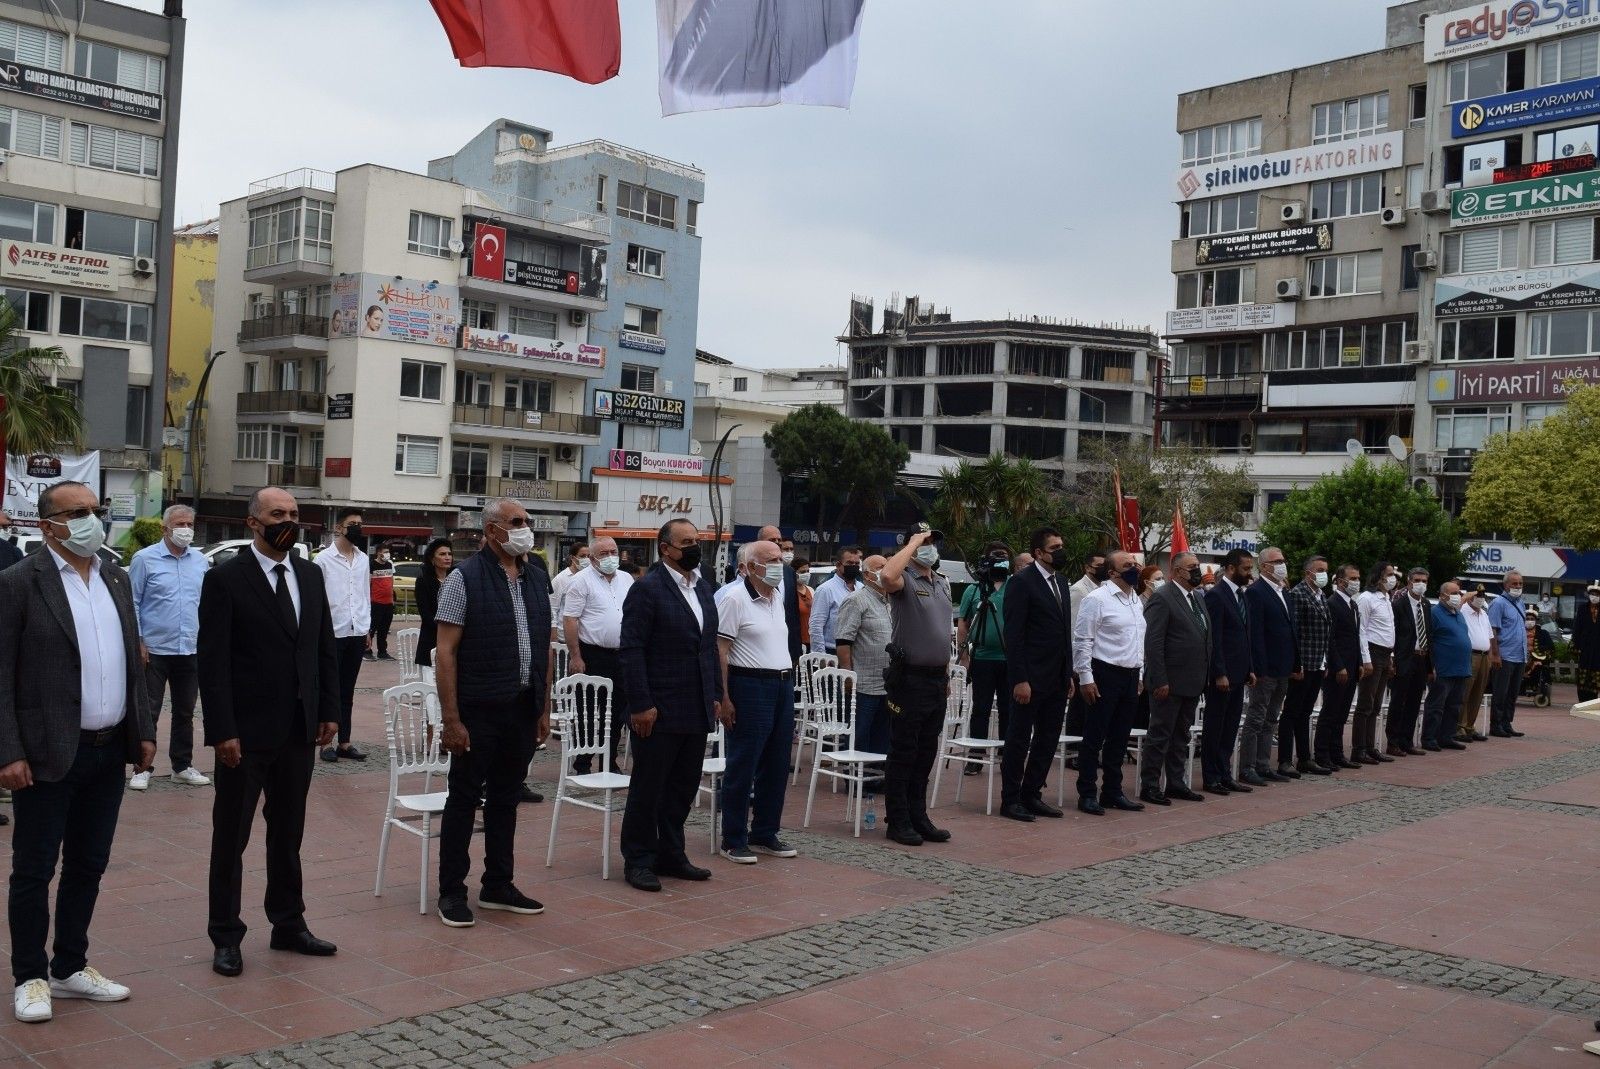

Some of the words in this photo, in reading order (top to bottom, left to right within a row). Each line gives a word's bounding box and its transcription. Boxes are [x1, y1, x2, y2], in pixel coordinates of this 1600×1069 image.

[24, 69, 49, 86] CANER
[50, 75, 75, 91] HARİTA
[76, 80, 114, 99] KADASTRO
[114, 88, 160, 110] MÜHENDİSLİK
[1486, 101, 1529, 118] KAMER
[1532, 88, 1594, 110] KARAMAN
[1205, 158, 1291, 192] ŞİRİNOĞLU
[1294, 142, 1392, 174] FAKTORİNG
[1484, 178, 1584, 210] ETKİN
[1212, 234, 1250, 246] BOZDEMİR
[1252, 231, 1278, 241] HUKUK
[1280, 226, 1313, 238] BÜROSU
[22, 248, 57, 262] ATEŞ
[60, 254, 110, 268] PETROL
[518, 271, 542, 281] DÜŞÜNCE
[527, 265, 559, 276] ATATÜRKÇÜ
[1518, 282, 1552, 290] BÜROSU
[1462, 374, 1483, 396] İYİ
[1488, 370, 1541, 394] PARTİ
[1552, 366, 1589, 380] ALİAĞA
[614, 392, 683, 414] SEZGİNLER
[626, 455, 639, 467] BG
[643, 456, 666, 468] Bayan
[667, 459, 702, 470] KUAFÖRÜ
[637, 494, 692, 514] SEÇ-AL
